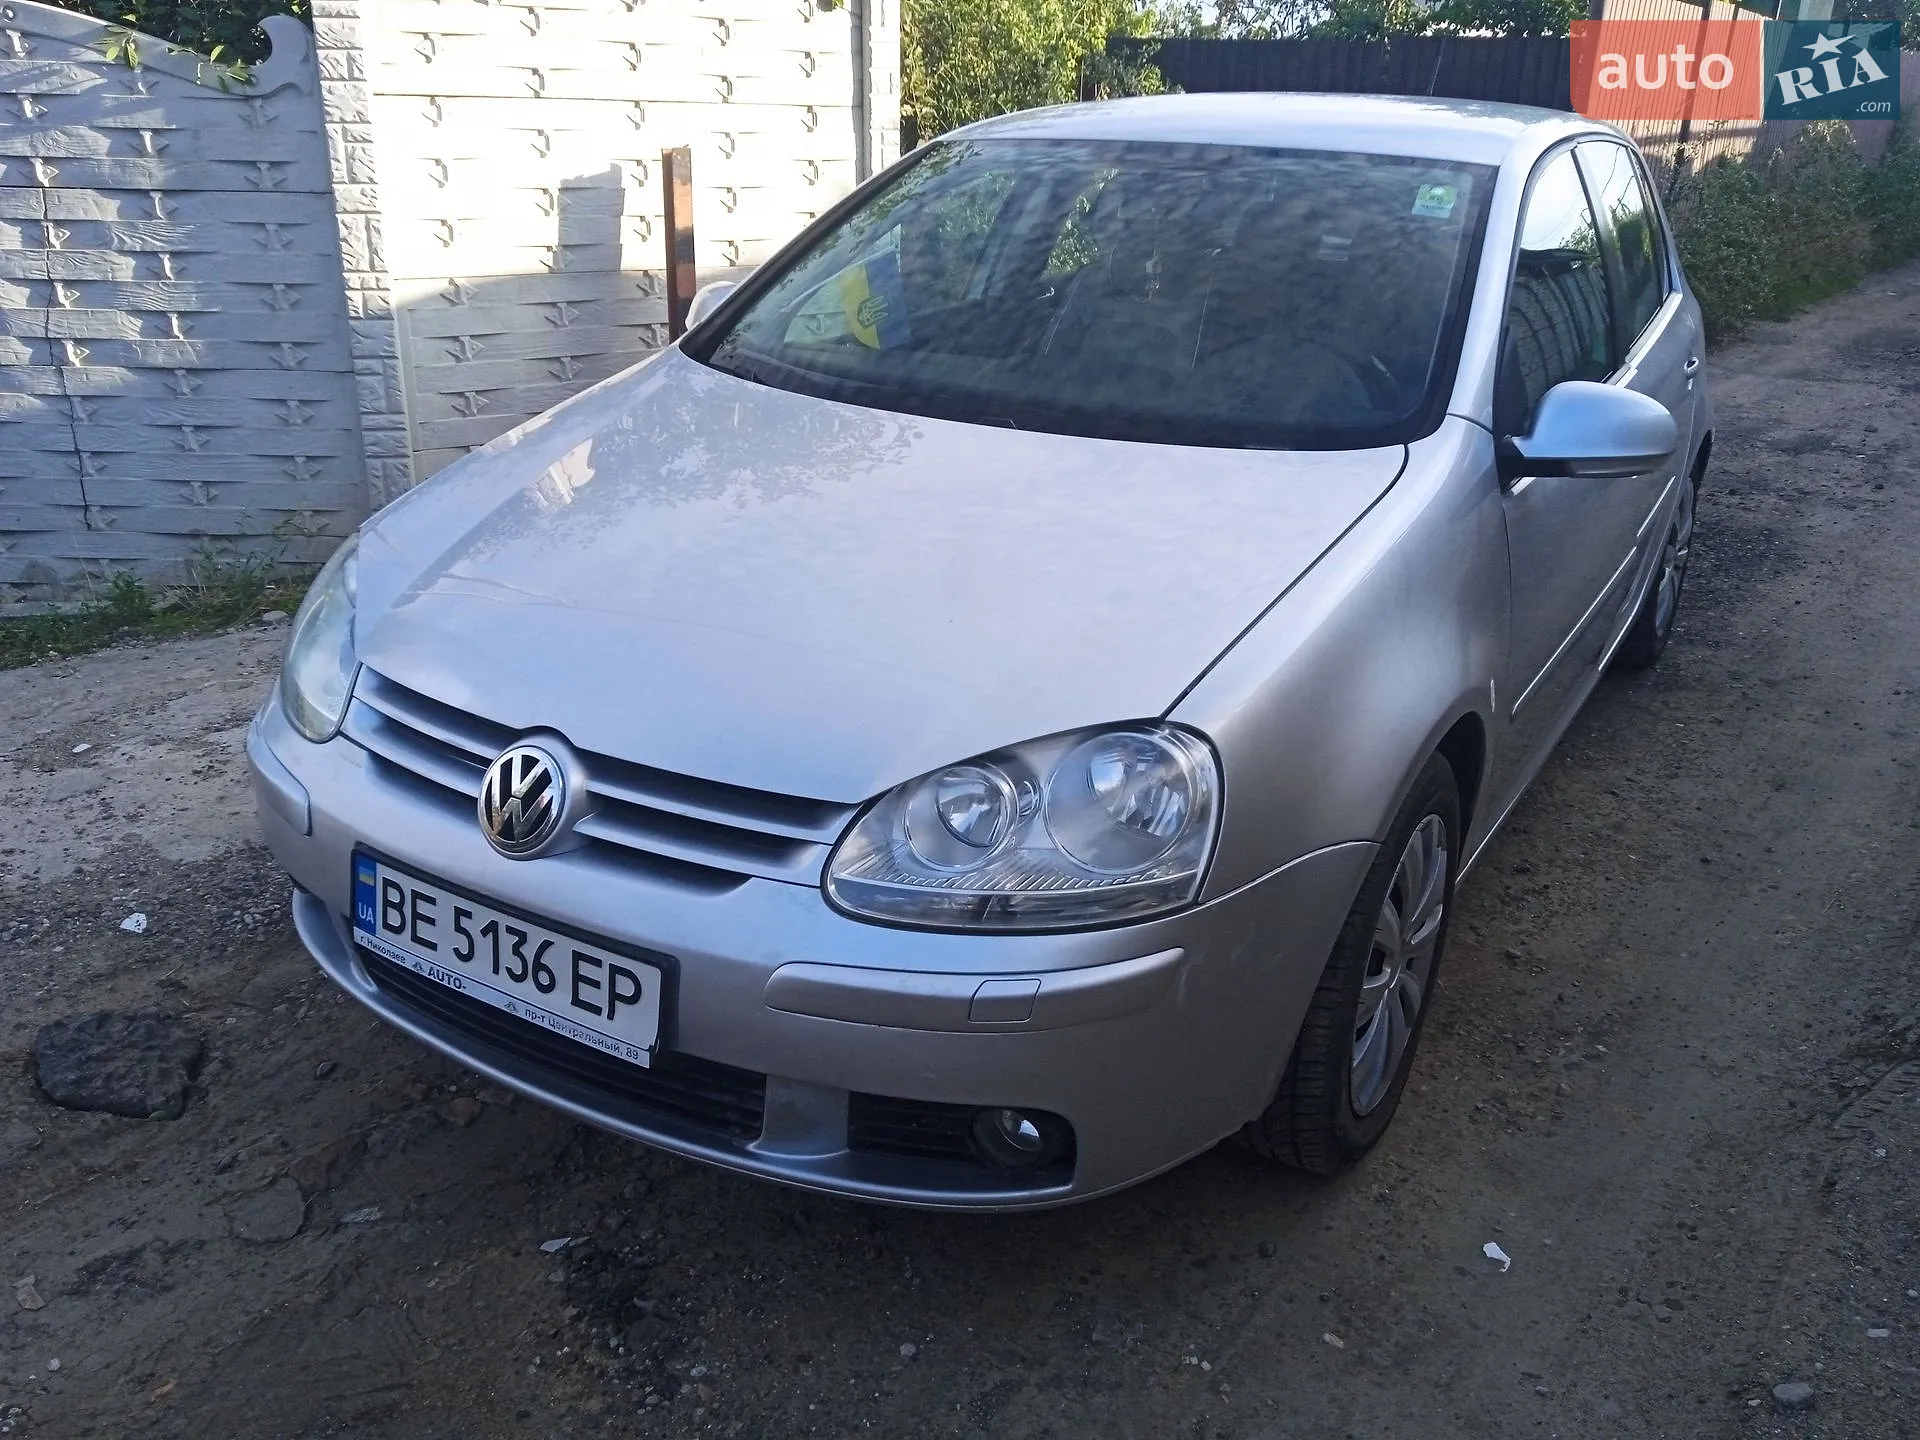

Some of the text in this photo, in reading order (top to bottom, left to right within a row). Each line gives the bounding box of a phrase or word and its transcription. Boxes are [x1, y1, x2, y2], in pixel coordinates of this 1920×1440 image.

[358, 902, 375, 925] UA
[382, 876, 642, 1021] BE 5136 EP
[524, 1007, 546, 1024] пр-т
[625, 1047, 640, 1061] 89
